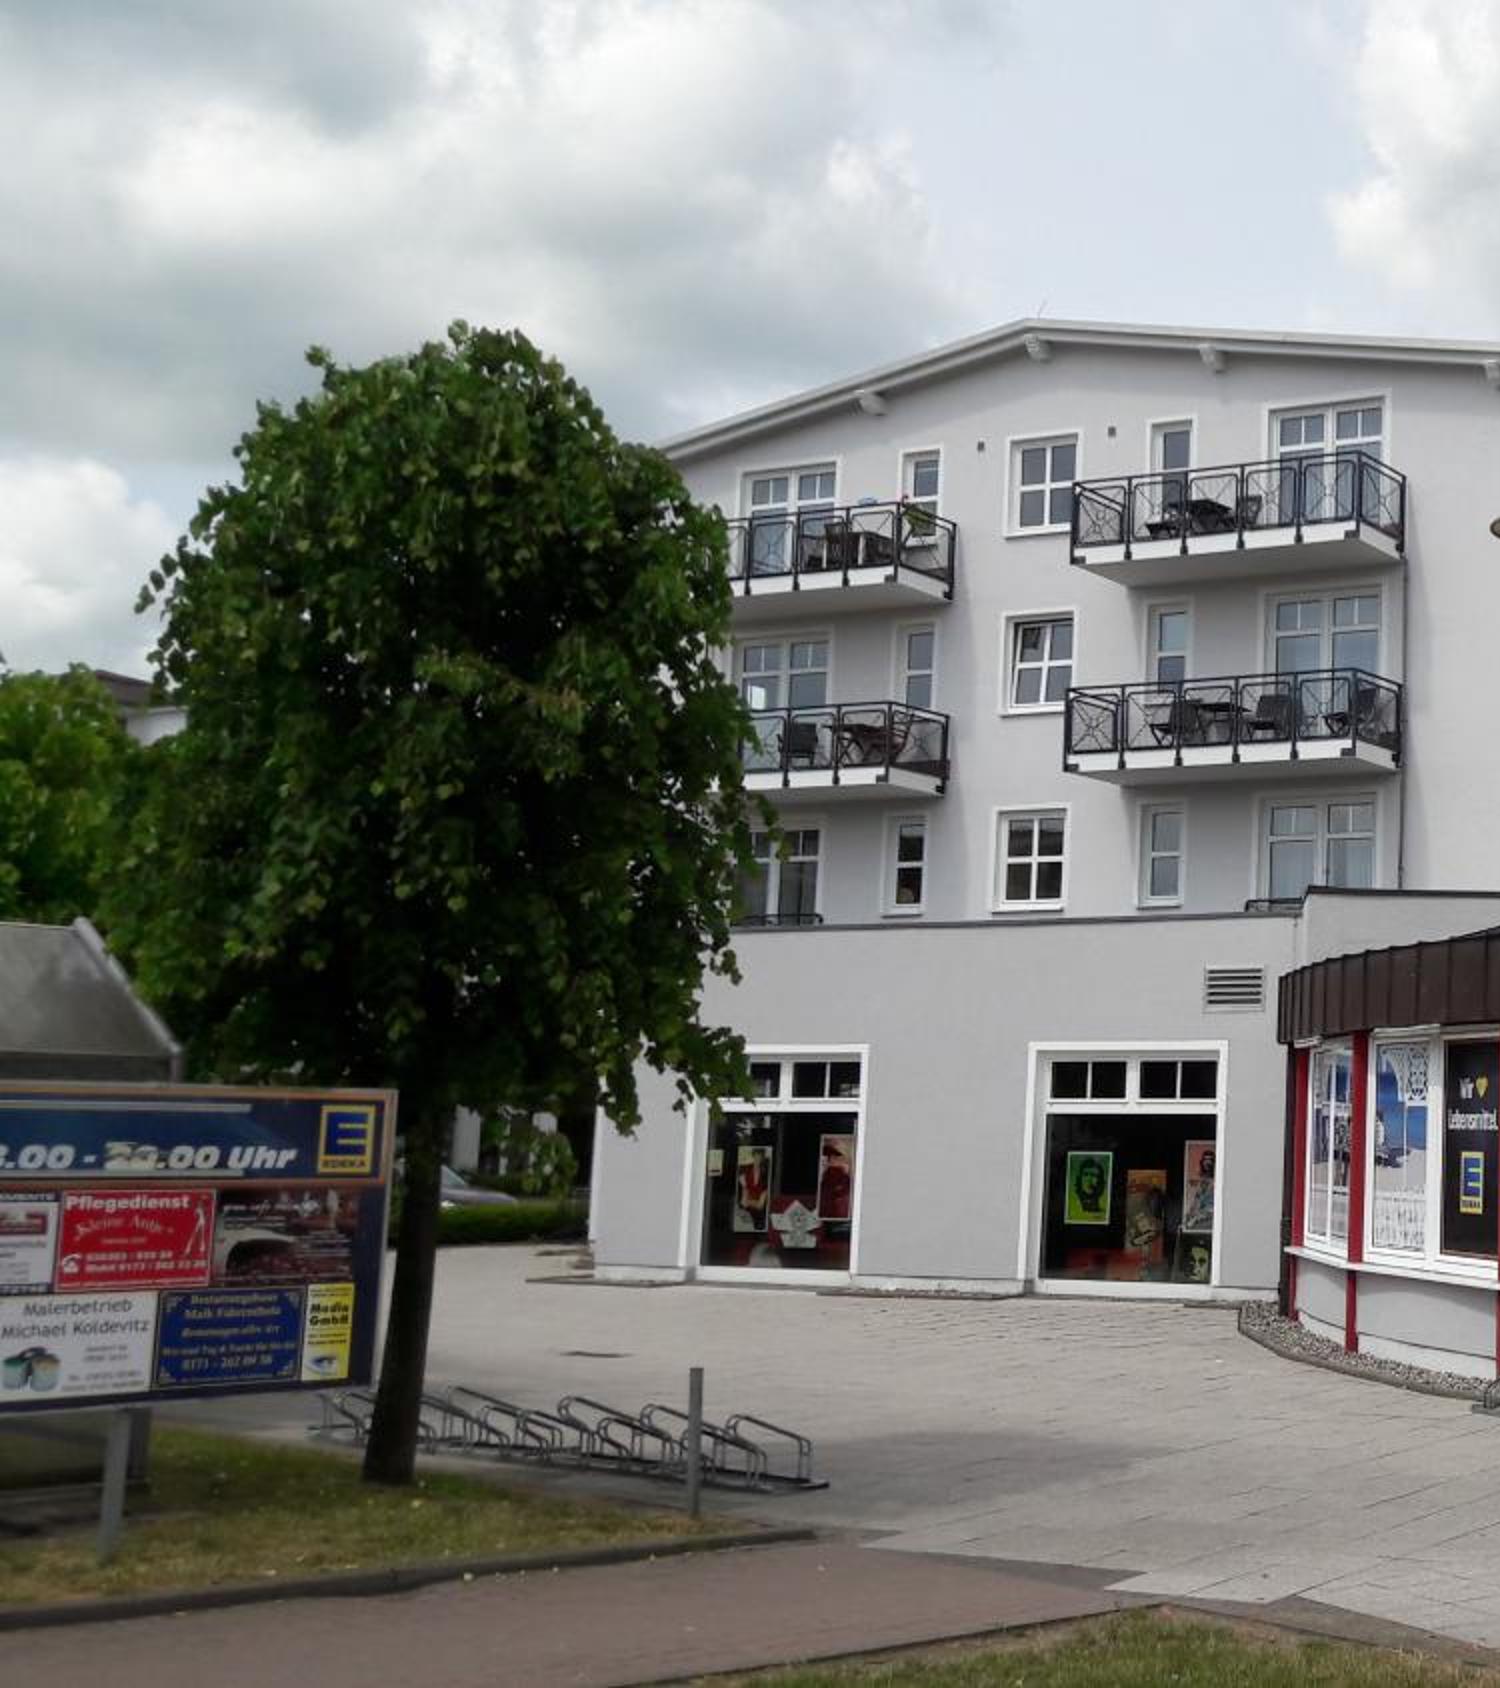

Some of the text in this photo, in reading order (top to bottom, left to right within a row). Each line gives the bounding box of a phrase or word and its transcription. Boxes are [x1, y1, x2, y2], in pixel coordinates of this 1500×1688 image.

[227, 1145, 298, 1169] Uhr
[65, 1194, 191, 1214] Pflegedienst
[23, 1299, 132, 1317] Malerbetrieb
[1, 1319, 150, 1340] Michael Koldevitz
